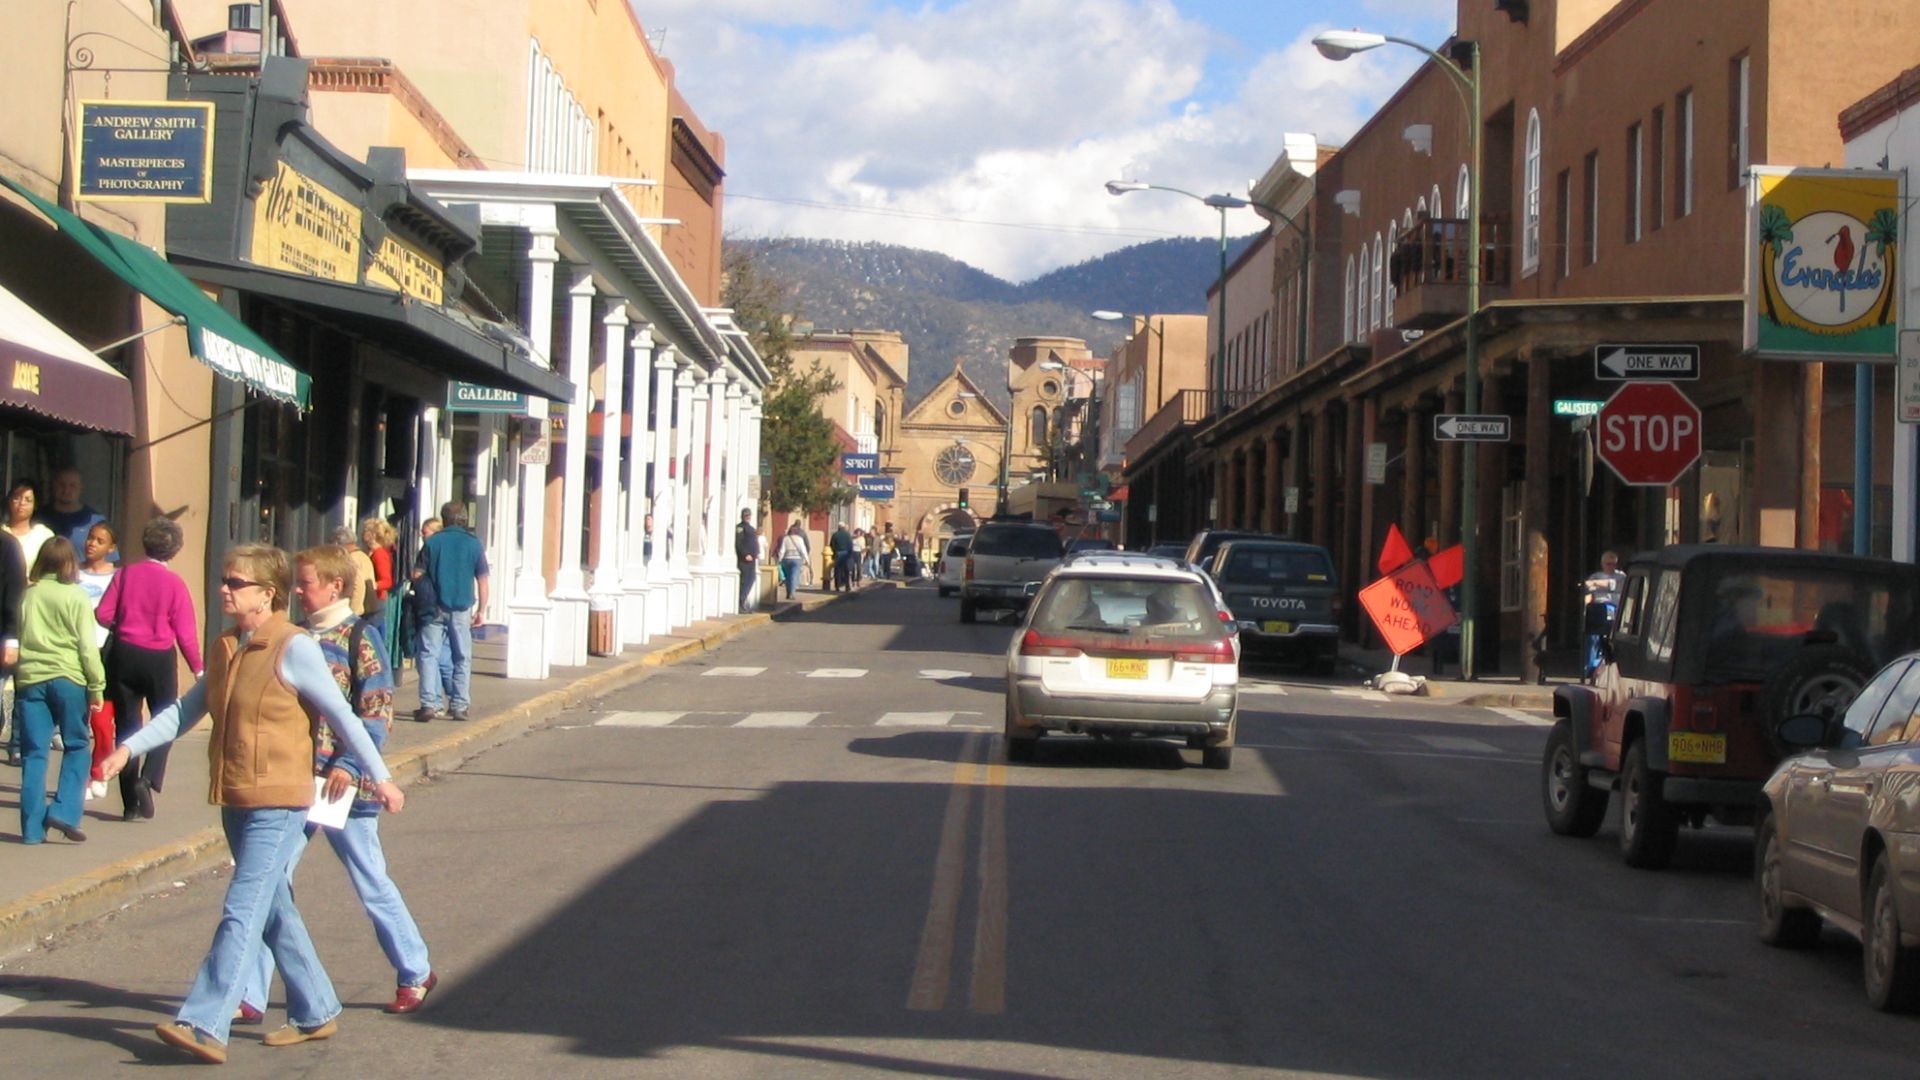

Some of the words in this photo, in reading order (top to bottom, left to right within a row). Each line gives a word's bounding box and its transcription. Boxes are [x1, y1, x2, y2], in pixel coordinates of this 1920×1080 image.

[94, 115, 152, 128] ANDREW
[154, 117, 196, 129] SMITH
[115, 128, 174, 140] GALLERY
[99, 157, 185, 168] MASTERPIECES
[98, 179, 184, 190] PHOTOGRAPHY
[1781, 242, 1882, 313] Evangelo's
[1626, 356, 1654, 368] ONE
[1659, 356, 1687, 368] WAY
[458, 387, 518, 401] GALLERY
[1557, 401, 1598, 414] GALISTEO
[1457, 423, 1477, 433] ONE
[1480, 423, 1502, 433] WAY
[1605, 414, 1694, 452] STOP
[845, 458, 874, 469] SPIRIT
[1250, 596, 1306, 610] TOYOTA
[1382, 613, 1432, 634] AHEAD
